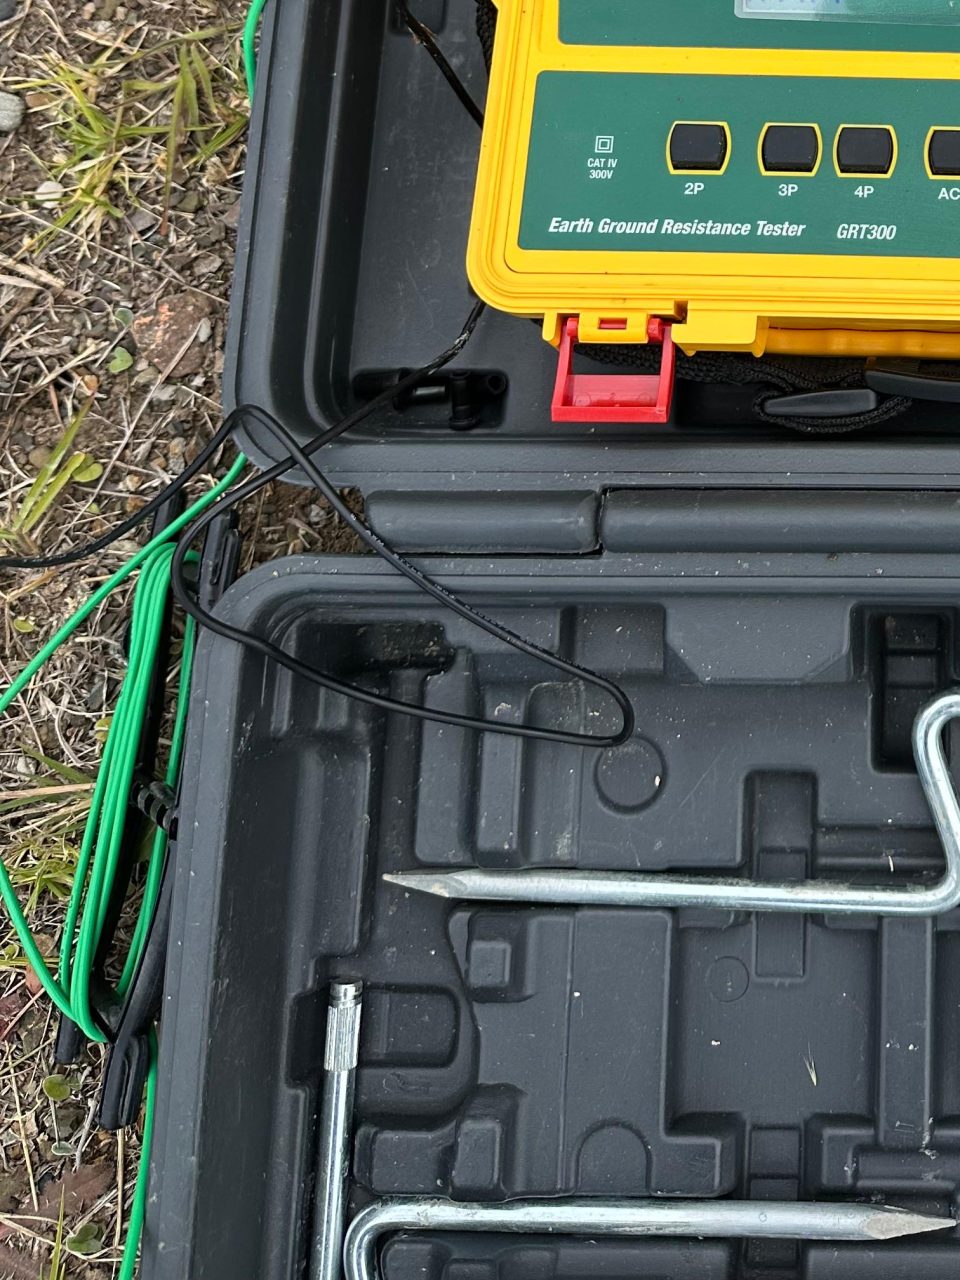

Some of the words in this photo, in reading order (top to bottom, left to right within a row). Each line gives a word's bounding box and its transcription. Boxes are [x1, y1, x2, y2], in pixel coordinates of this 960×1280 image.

[587, 157, 606, 168] CAT
[607, 158, 618, 168] IV
[589, 169, 613, 179] 300V
[684, 182, 704, 195] 2P
[778, 183, 798, 196] 3P
[854, 185, 874, 198] 4P
[548, 217, 594, 233] Earth
[597, 217, 659, 234] Ground
[660, 218, 751, 235] Resistance
[756, 220, 806, 236] Tester
[836, 223, 897, 240] GRT300
